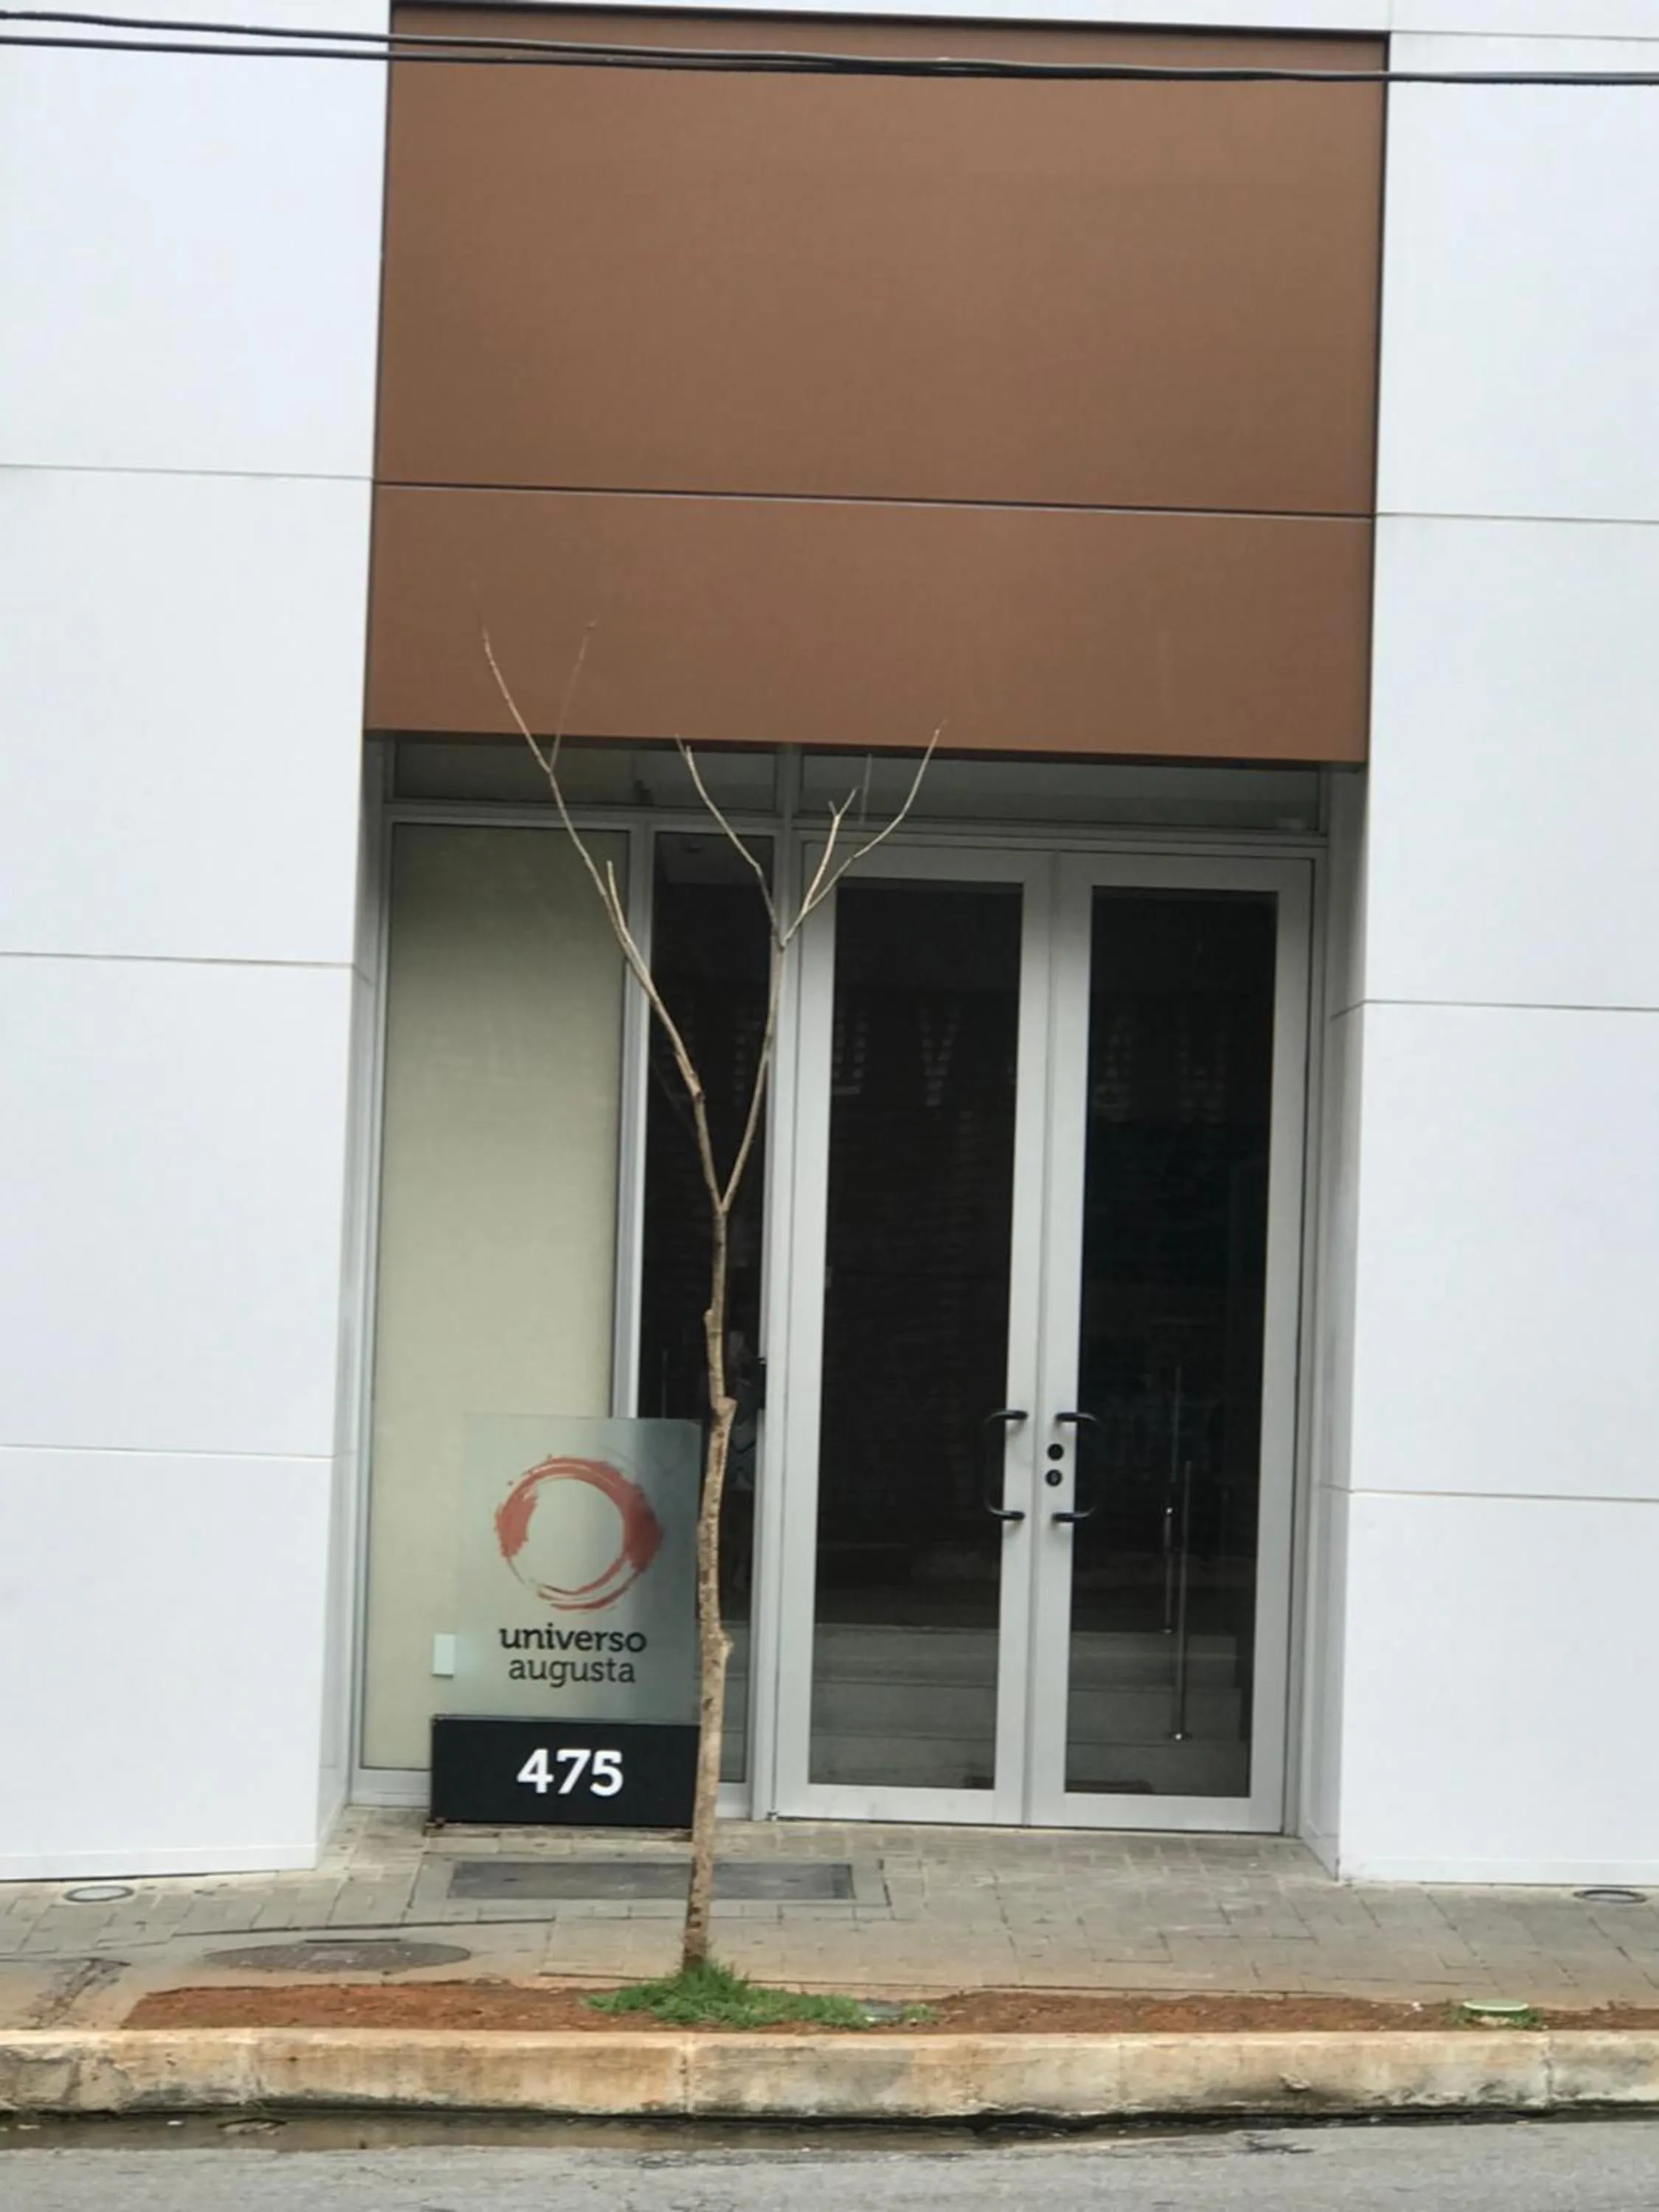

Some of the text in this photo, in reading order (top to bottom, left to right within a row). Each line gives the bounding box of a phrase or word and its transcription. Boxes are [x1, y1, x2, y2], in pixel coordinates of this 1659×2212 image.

[499, 1623, 647, 1653] universo
[509, 1658, 636, 1688] augusta
[517, 1748, 625, 1797] 475
